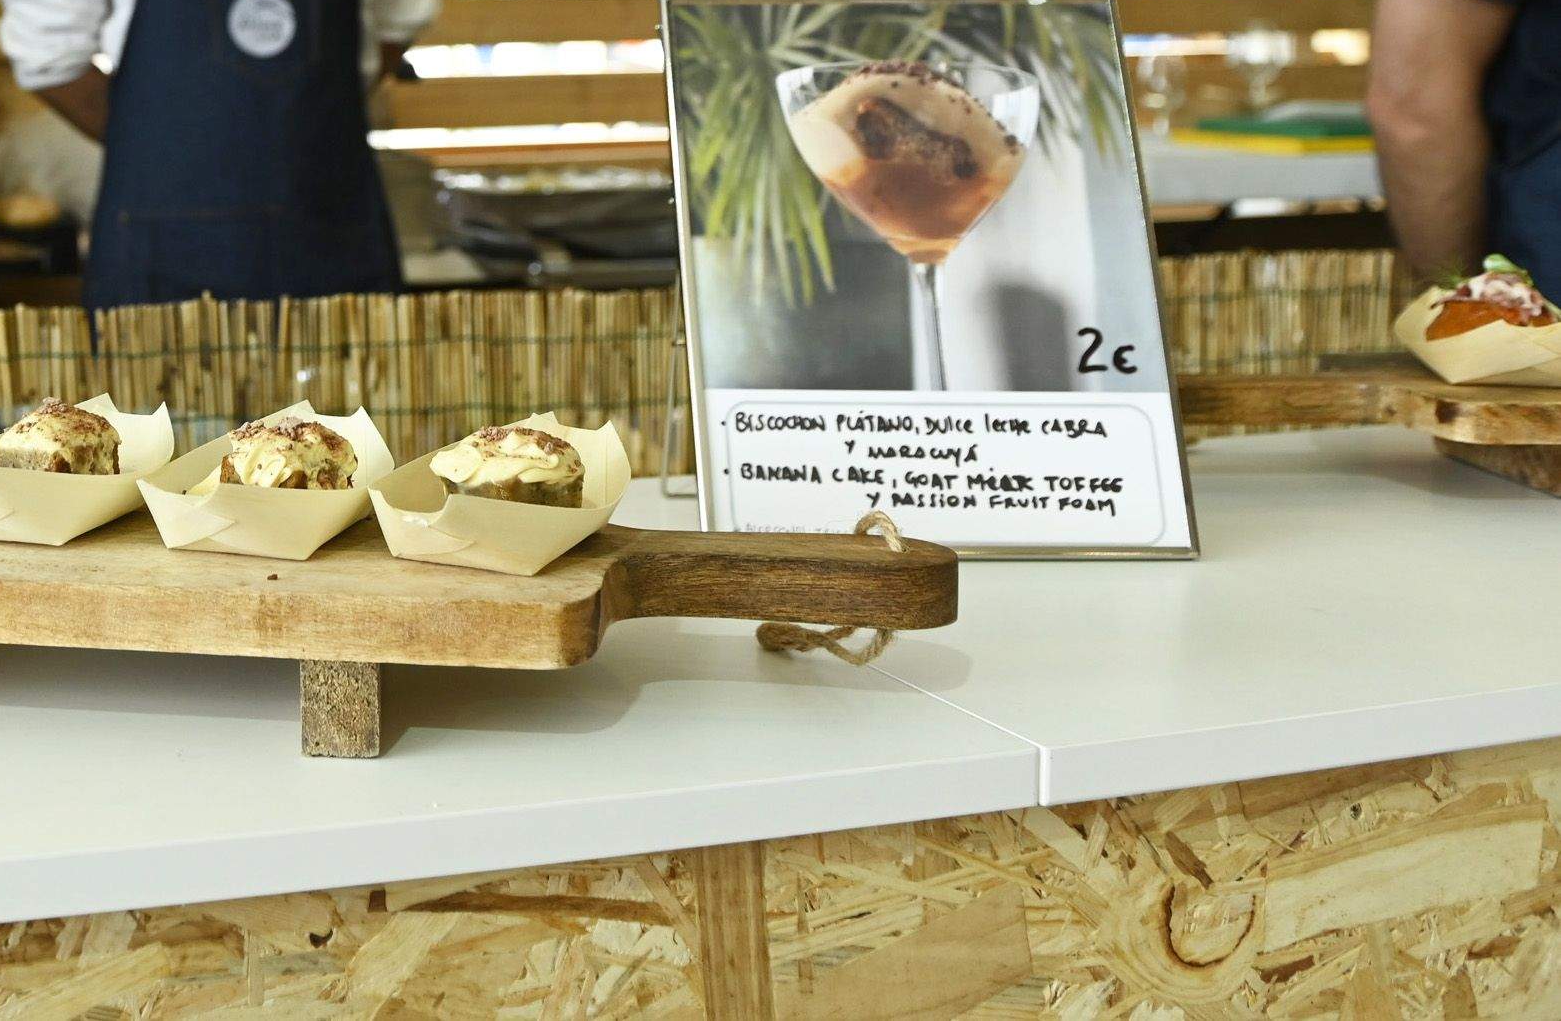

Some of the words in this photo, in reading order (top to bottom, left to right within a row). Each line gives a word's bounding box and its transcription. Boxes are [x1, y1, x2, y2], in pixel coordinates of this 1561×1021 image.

[1077, 327, 1138, 375] 2€
[1041, 418, 1108, 439] CABRA
[740, 462, 822, 484] BANANA
[904, 470, 960, 491] GOAT
[989, 494, 1050, 510] FRUIT
[1058, 496, 1117, 517] FOAM
